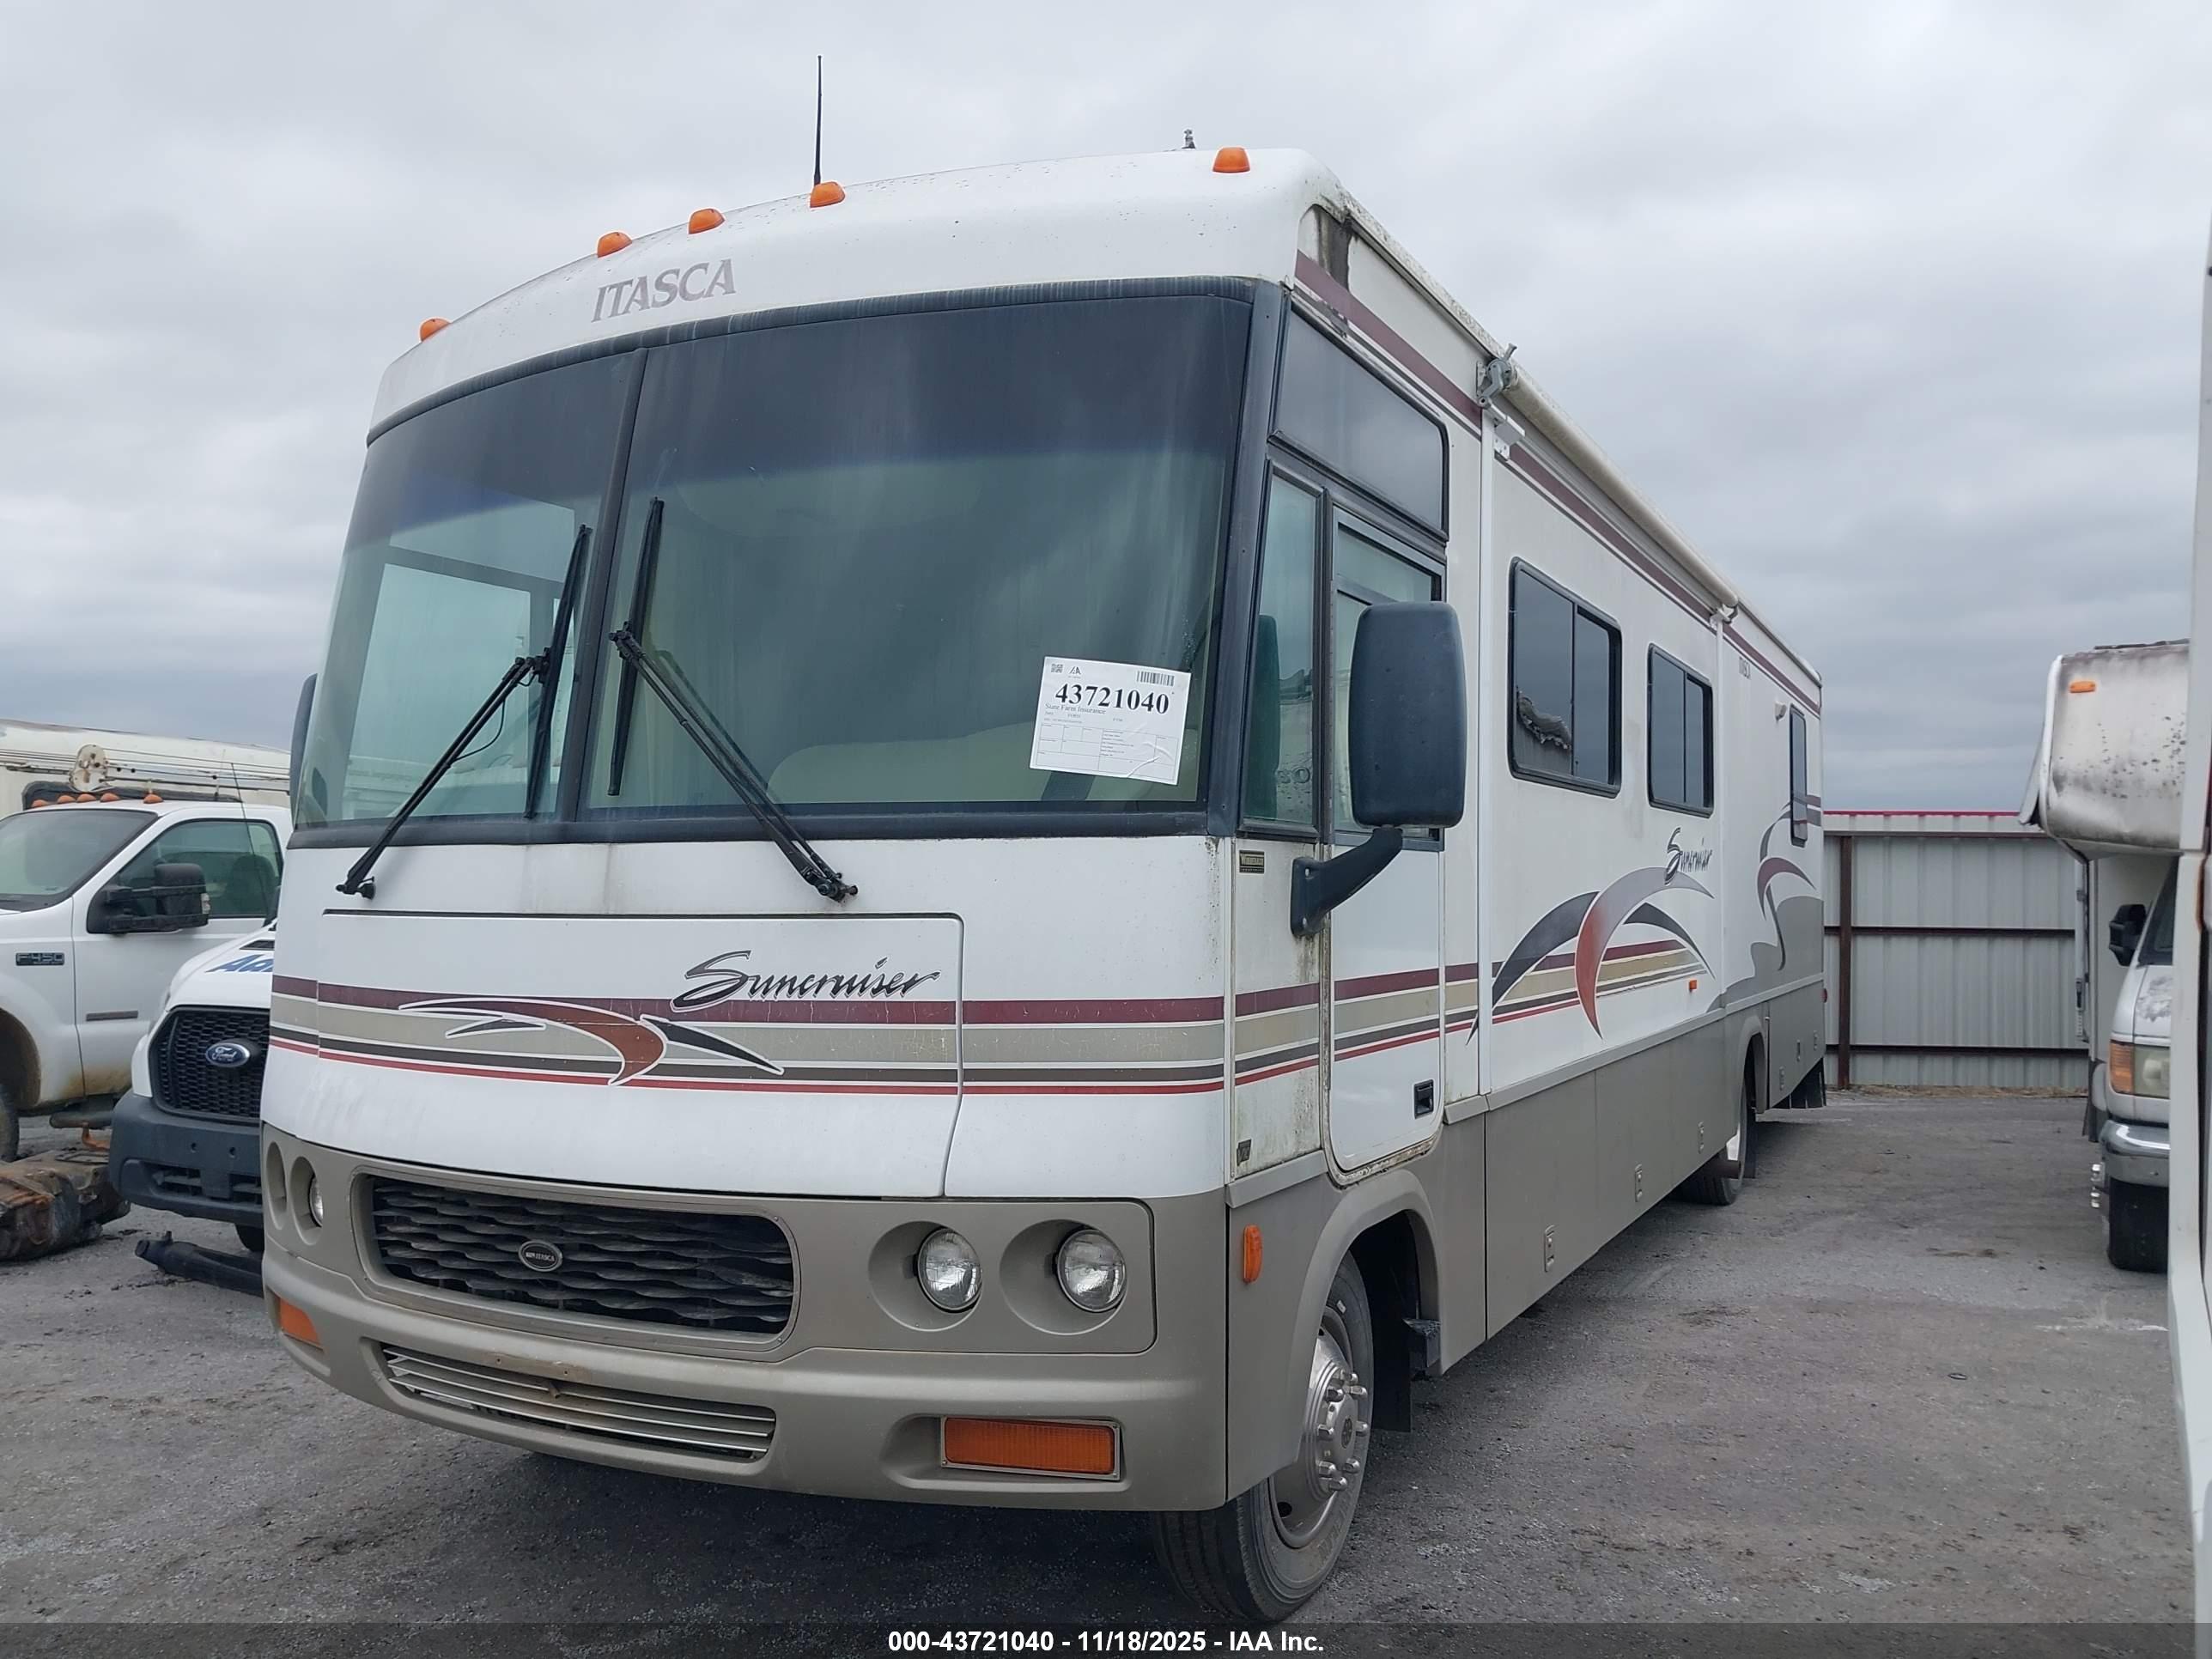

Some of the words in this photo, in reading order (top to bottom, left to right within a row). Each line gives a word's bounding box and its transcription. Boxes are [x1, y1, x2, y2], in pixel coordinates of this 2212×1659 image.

[591, 258, 737, 323] ITASCA
[1054, 684, 1170, 714] 43721040
[204, 954, 275, 973] Aa
[670, 950, 941, 1011] Suncruiser
